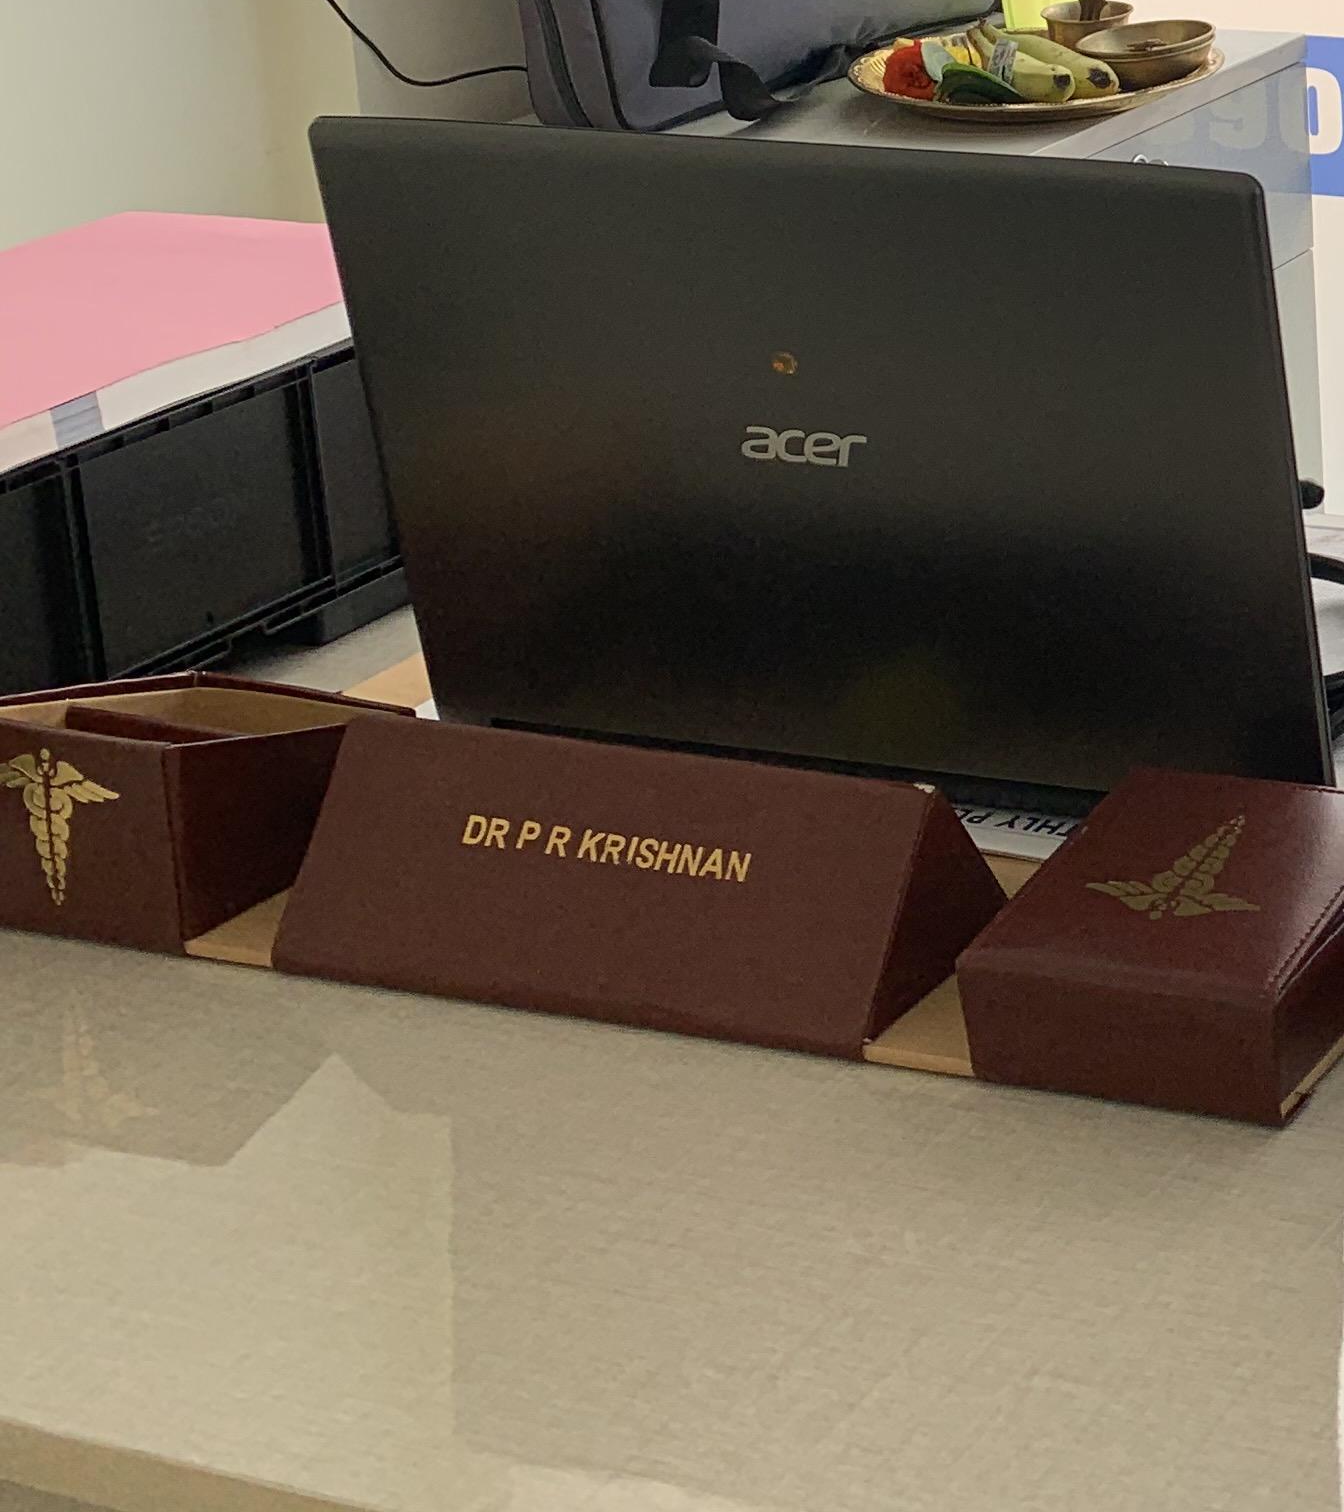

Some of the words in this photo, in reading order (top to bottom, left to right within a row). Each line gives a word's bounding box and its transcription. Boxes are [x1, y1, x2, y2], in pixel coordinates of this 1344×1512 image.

[741, 425, 868, 468] acer
[461, 813, 510, 849] DR
[514, 819, 542, 850] P
[544, 825, 572, 858] R
[576, 828, 752, 883] KRISHNAN
